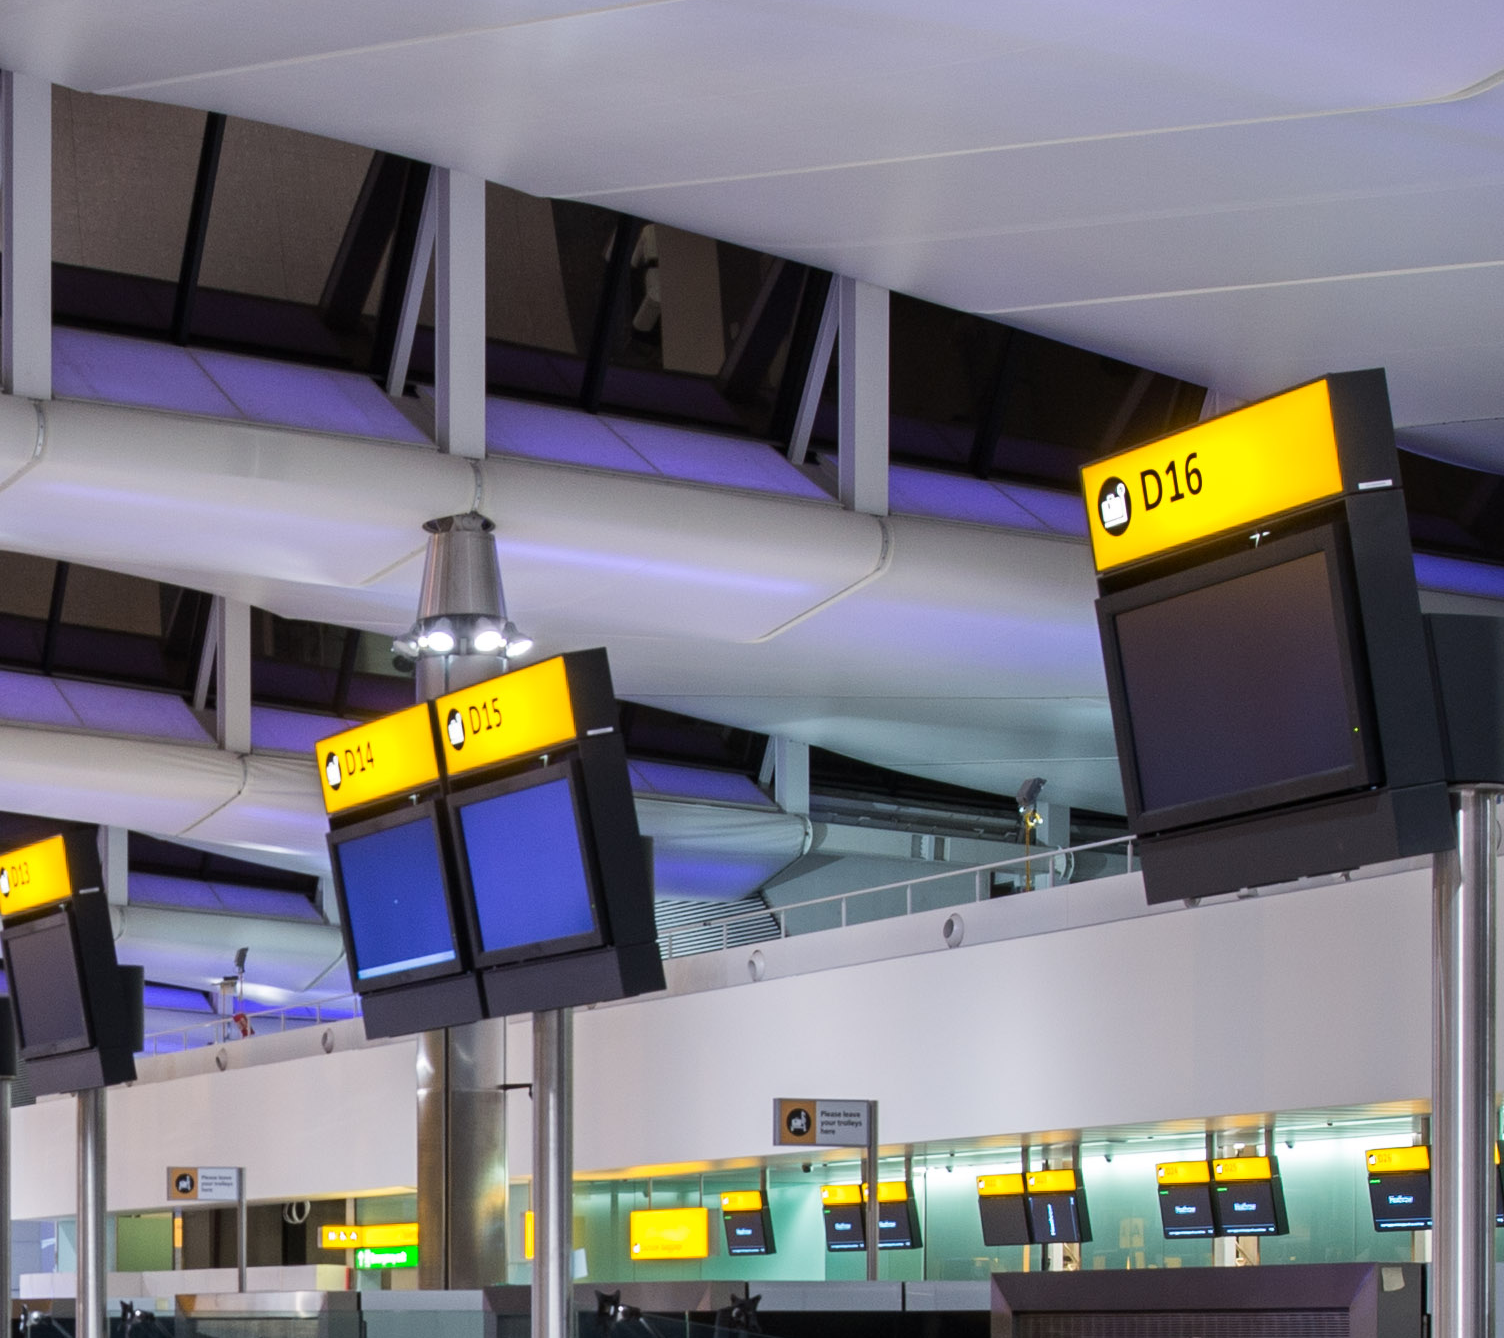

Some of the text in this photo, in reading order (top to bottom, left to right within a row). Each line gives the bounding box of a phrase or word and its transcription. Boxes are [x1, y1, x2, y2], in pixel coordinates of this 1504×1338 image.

[1139, 451, 1203, 512] D16
[468, 697, 503, 736] D15
[344, 741, 375, 777] D14
[10, 861, 31, 888] D13
[820, 1110, 842, 1118] Please
